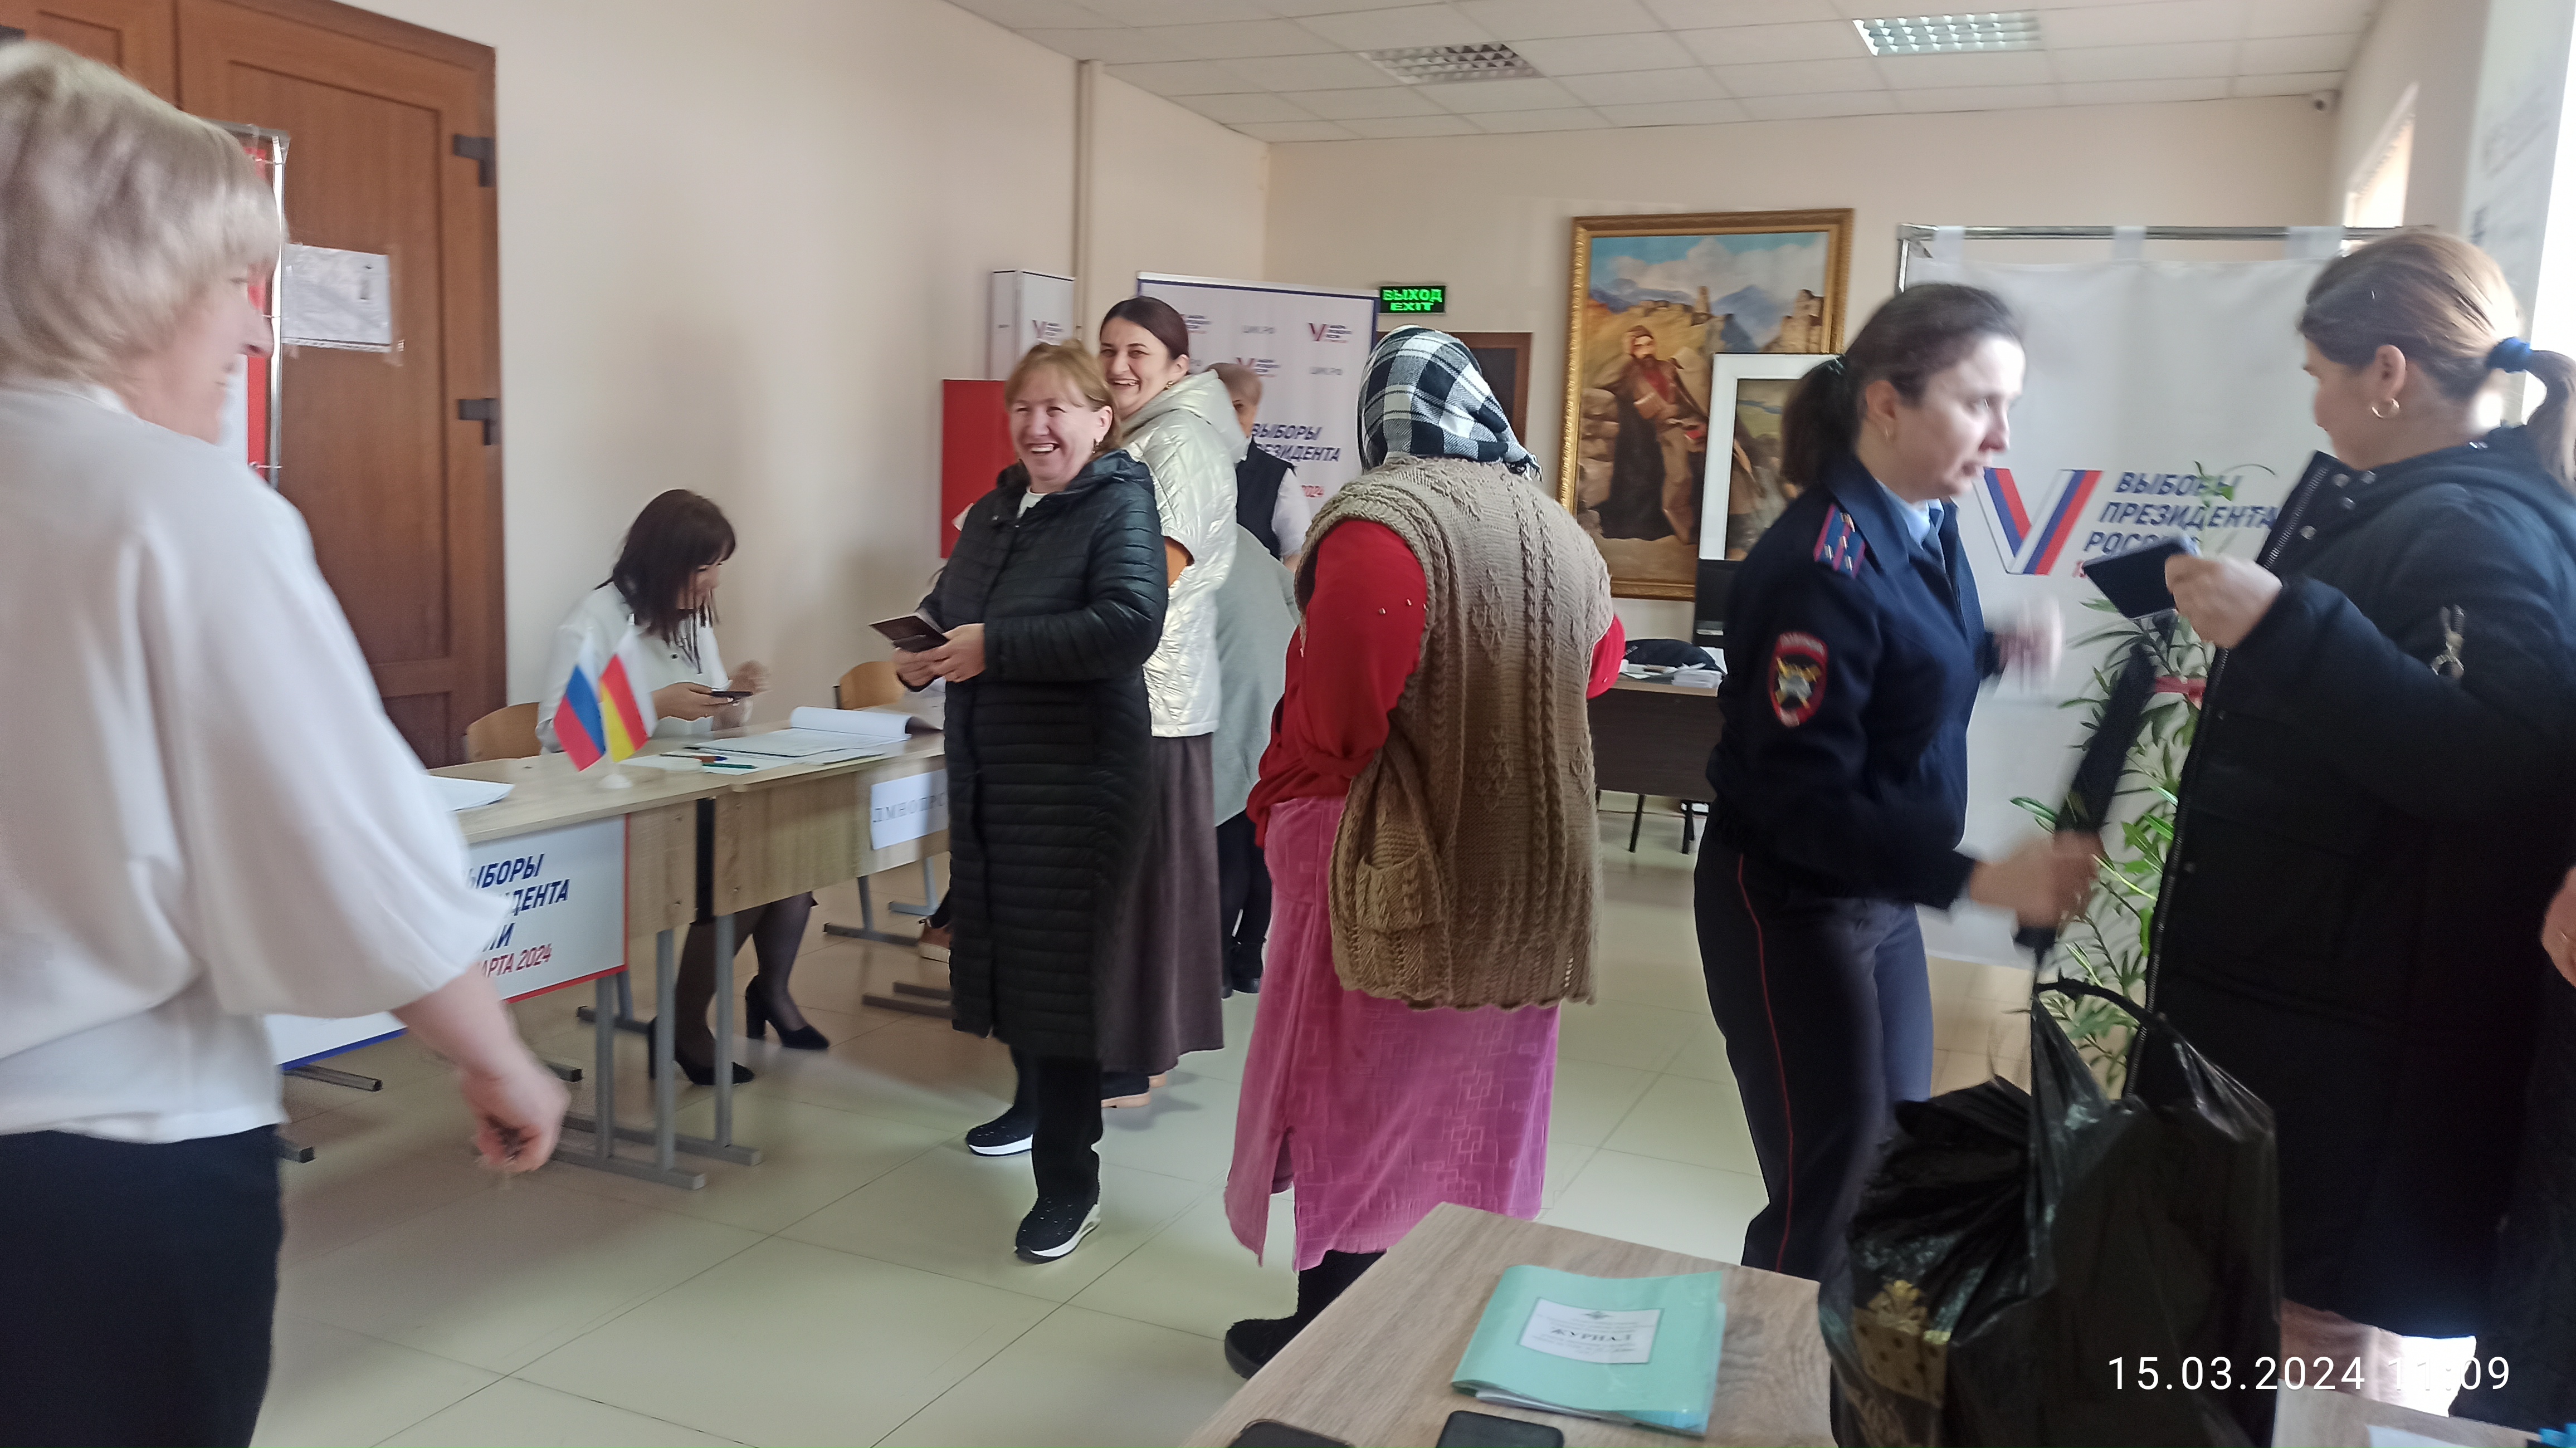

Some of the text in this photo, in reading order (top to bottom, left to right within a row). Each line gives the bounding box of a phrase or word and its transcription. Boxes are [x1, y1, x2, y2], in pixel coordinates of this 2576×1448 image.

[1382, 288, 1442, 302] ВЫХОД
[1391, 302, 1434, 311] EXIT
[1252, 423, 1322, 441] ВЫБОРЫ
[468, 853, 544, 889] ЫБОРЫ
[516, 942, 553, 971] 2024
